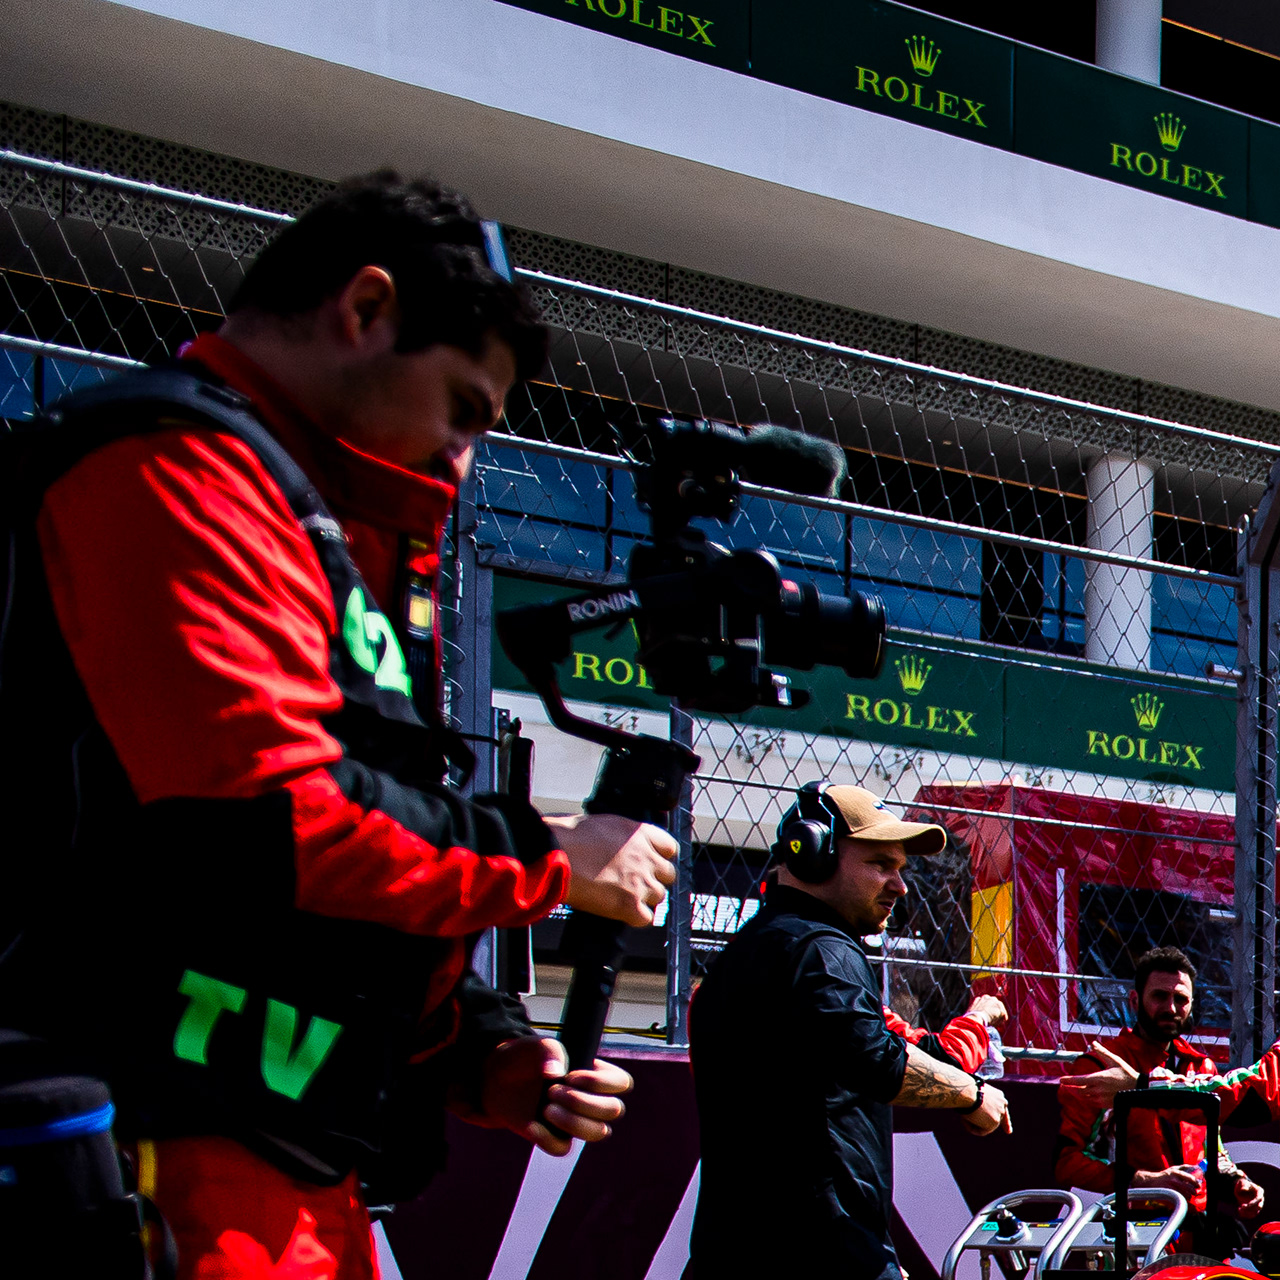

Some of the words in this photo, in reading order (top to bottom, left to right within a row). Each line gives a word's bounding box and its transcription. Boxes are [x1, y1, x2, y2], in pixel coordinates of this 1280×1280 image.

[854, 66, 988, 128] ROLEX
[1109, 142, 1227, 198] ROLEX
[567, 589, 642, 621] RONIN
[572, 652, 655, 689] ROL
[844, 693, 978, 738] ROLEX
[1086, 729, 1204, 771] ROLEX
[173, 967, 344, 1101] TV
